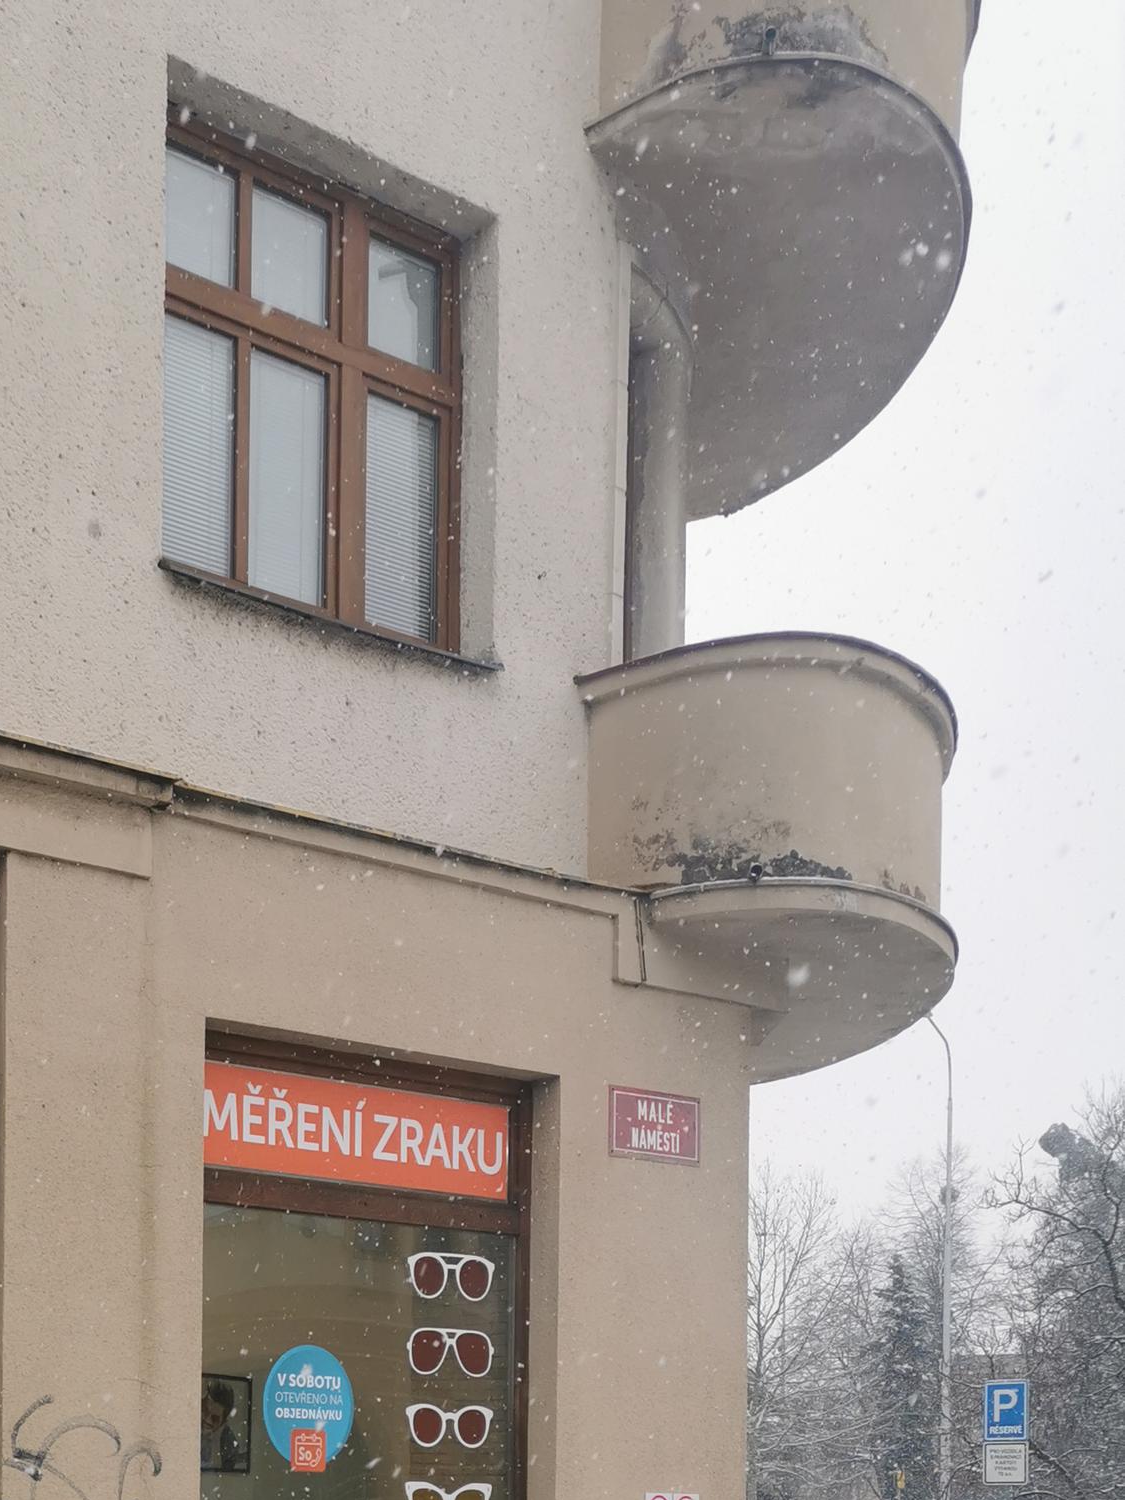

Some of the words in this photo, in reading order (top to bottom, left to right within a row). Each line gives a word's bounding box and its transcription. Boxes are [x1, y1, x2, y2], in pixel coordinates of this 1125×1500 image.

[637, 1100, 674, 1125] MALÉ
[203, 1081, 367, 1158] MĚŘENÍ
[372, 1113, 504, 1176] ZRAKU
[631, 1125, 680, 1154] NÁMĚSTÍ
[277, 1373, 287, 1387] V
[288, 1374, 342, 1389] SOBOTU
[275, 1391, 328, 1405] OTEVŘENO
[329, 1394, 343, 1406] NA
[992, 1388, 1020, 1423] P
[275, 1406, 343, 1421] OBJEDNÁVKU
[298, 1446, 313, 1461] So
